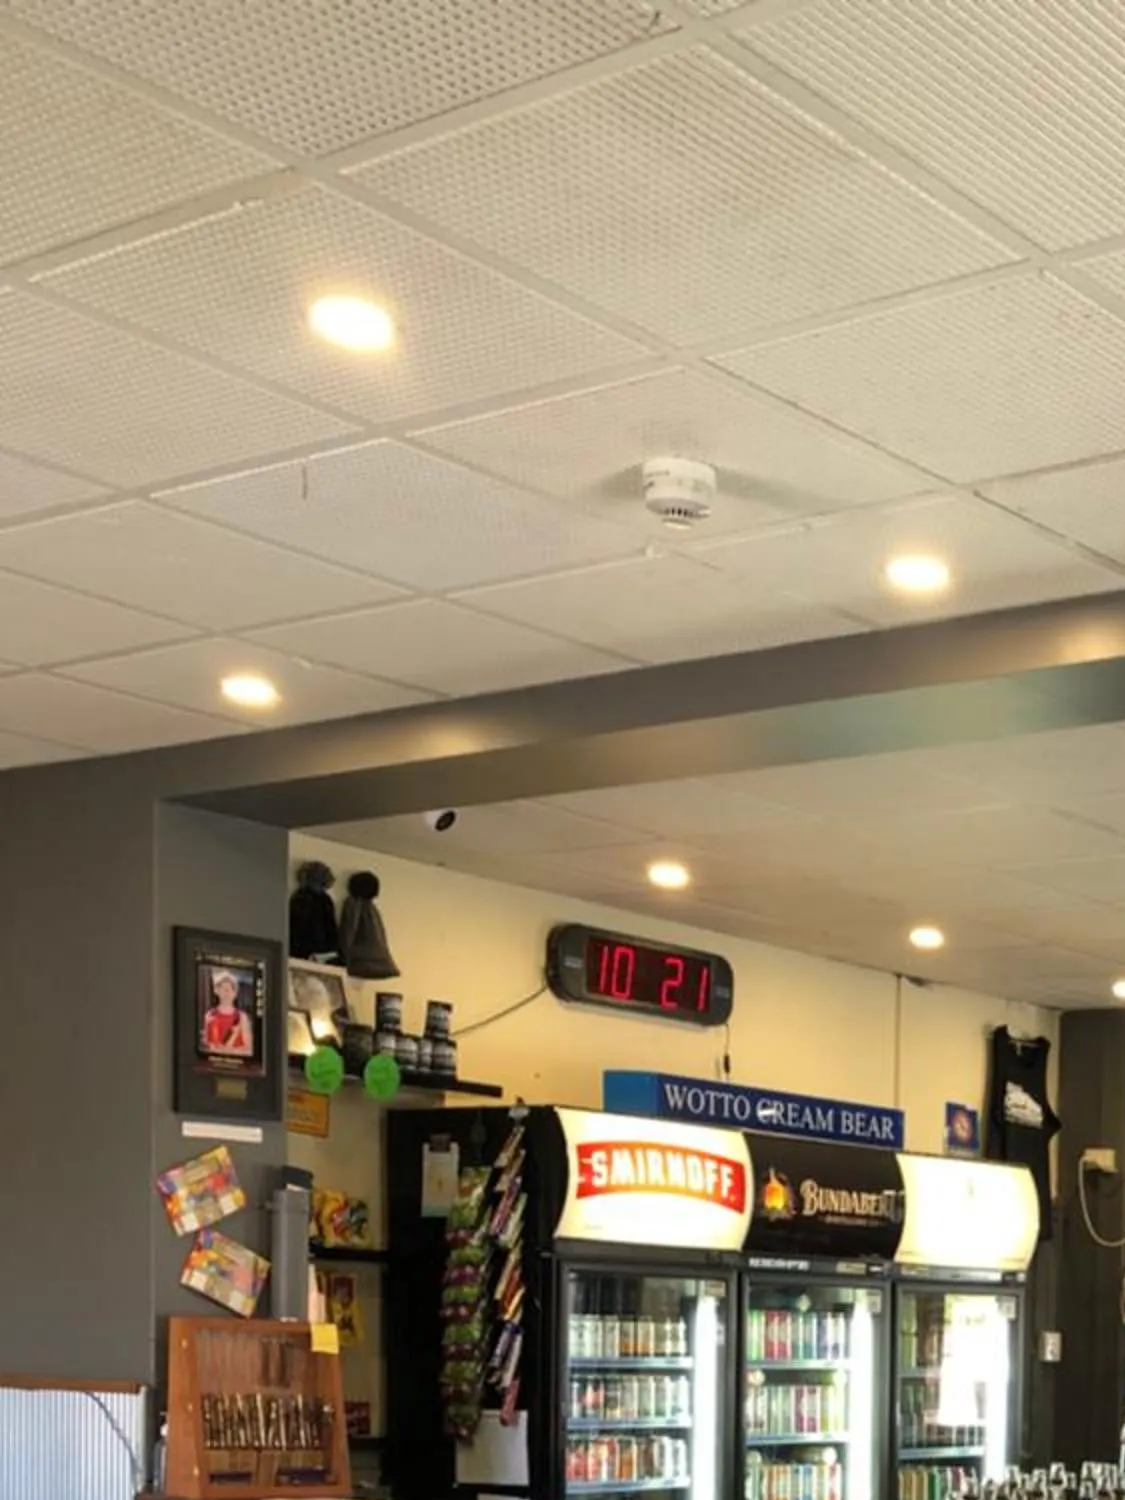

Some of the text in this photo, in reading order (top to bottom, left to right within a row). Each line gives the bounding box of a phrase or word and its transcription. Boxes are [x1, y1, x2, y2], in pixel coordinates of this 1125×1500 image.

[600, 945, 710, 1012] 10 21
[663, 1083, 895, 1141] WOTTO CREAM BEAR
[591, 1148, 734, 1199] SMIRNOFF
